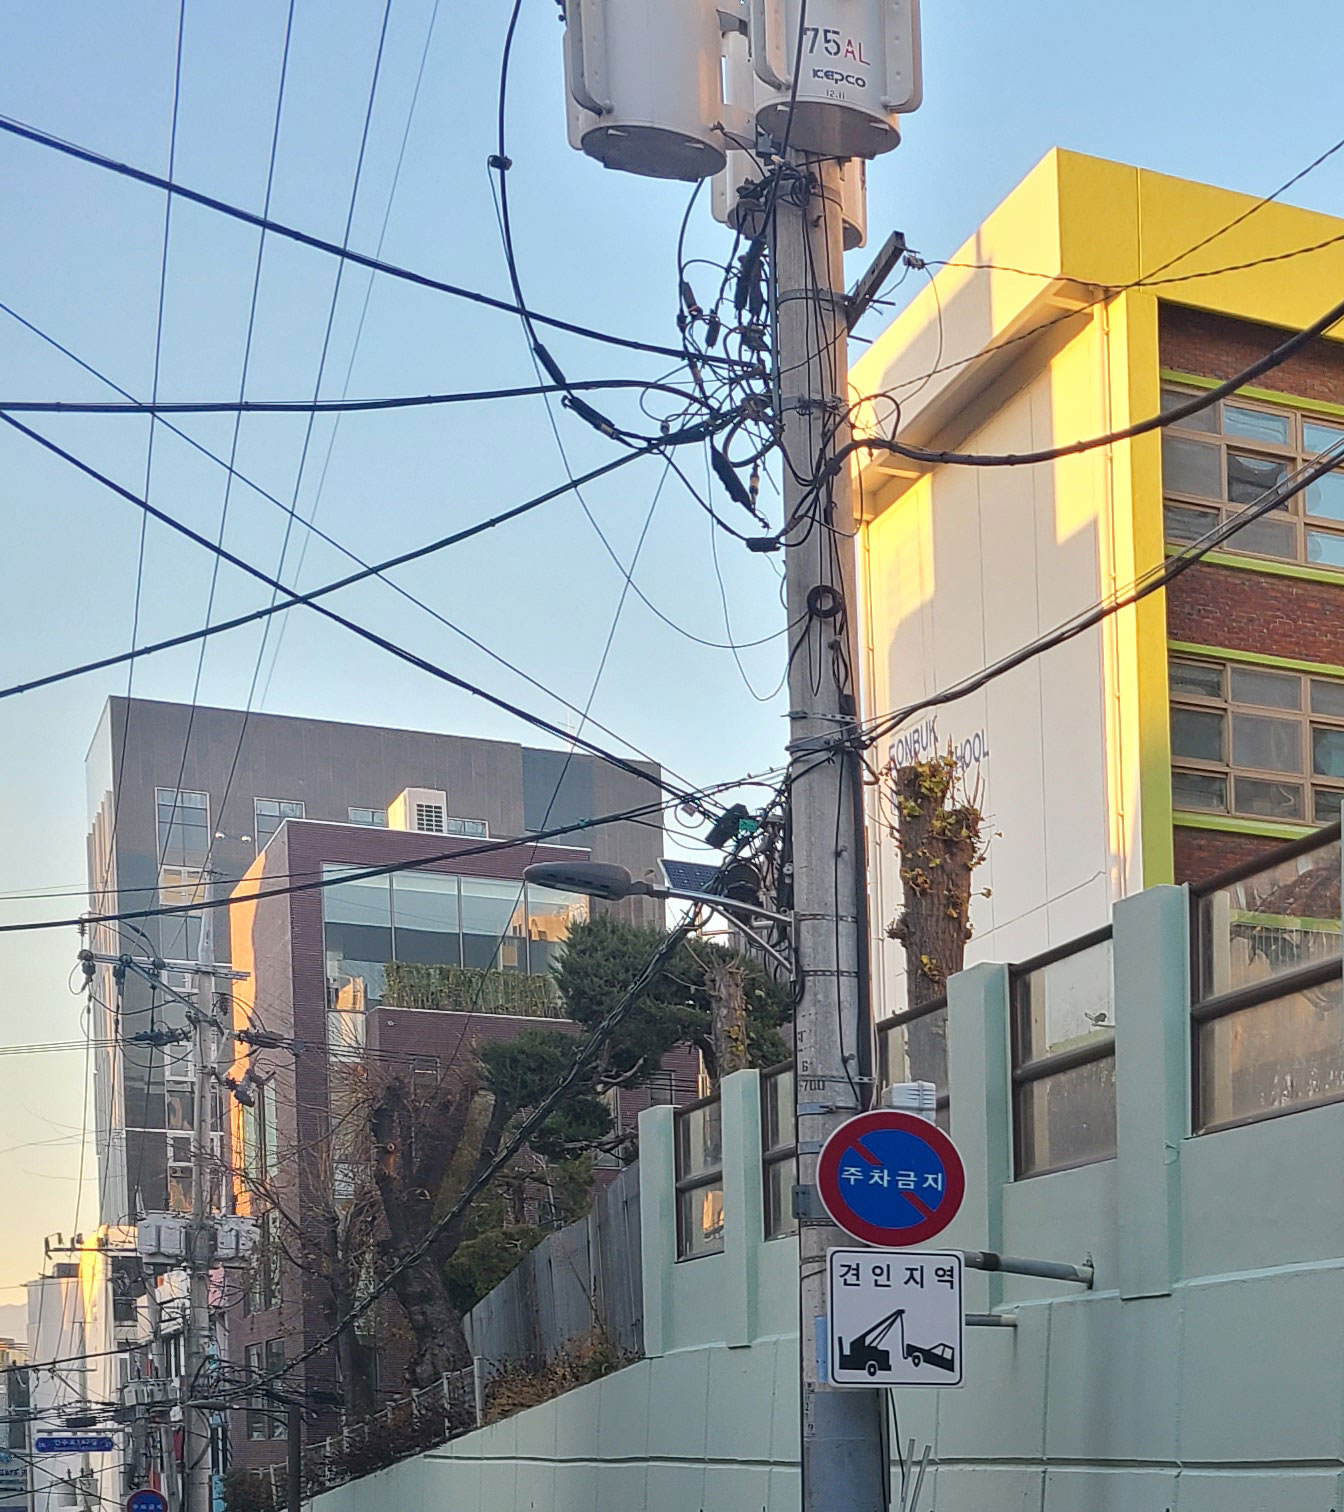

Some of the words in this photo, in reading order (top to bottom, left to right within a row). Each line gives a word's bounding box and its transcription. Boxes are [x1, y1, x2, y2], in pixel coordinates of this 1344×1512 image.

[812, 68, 867, 88] KEPCO
[841, 1165, 943, 1192] 주차금지
[838, 1262, 955, 1290] 견인지역
